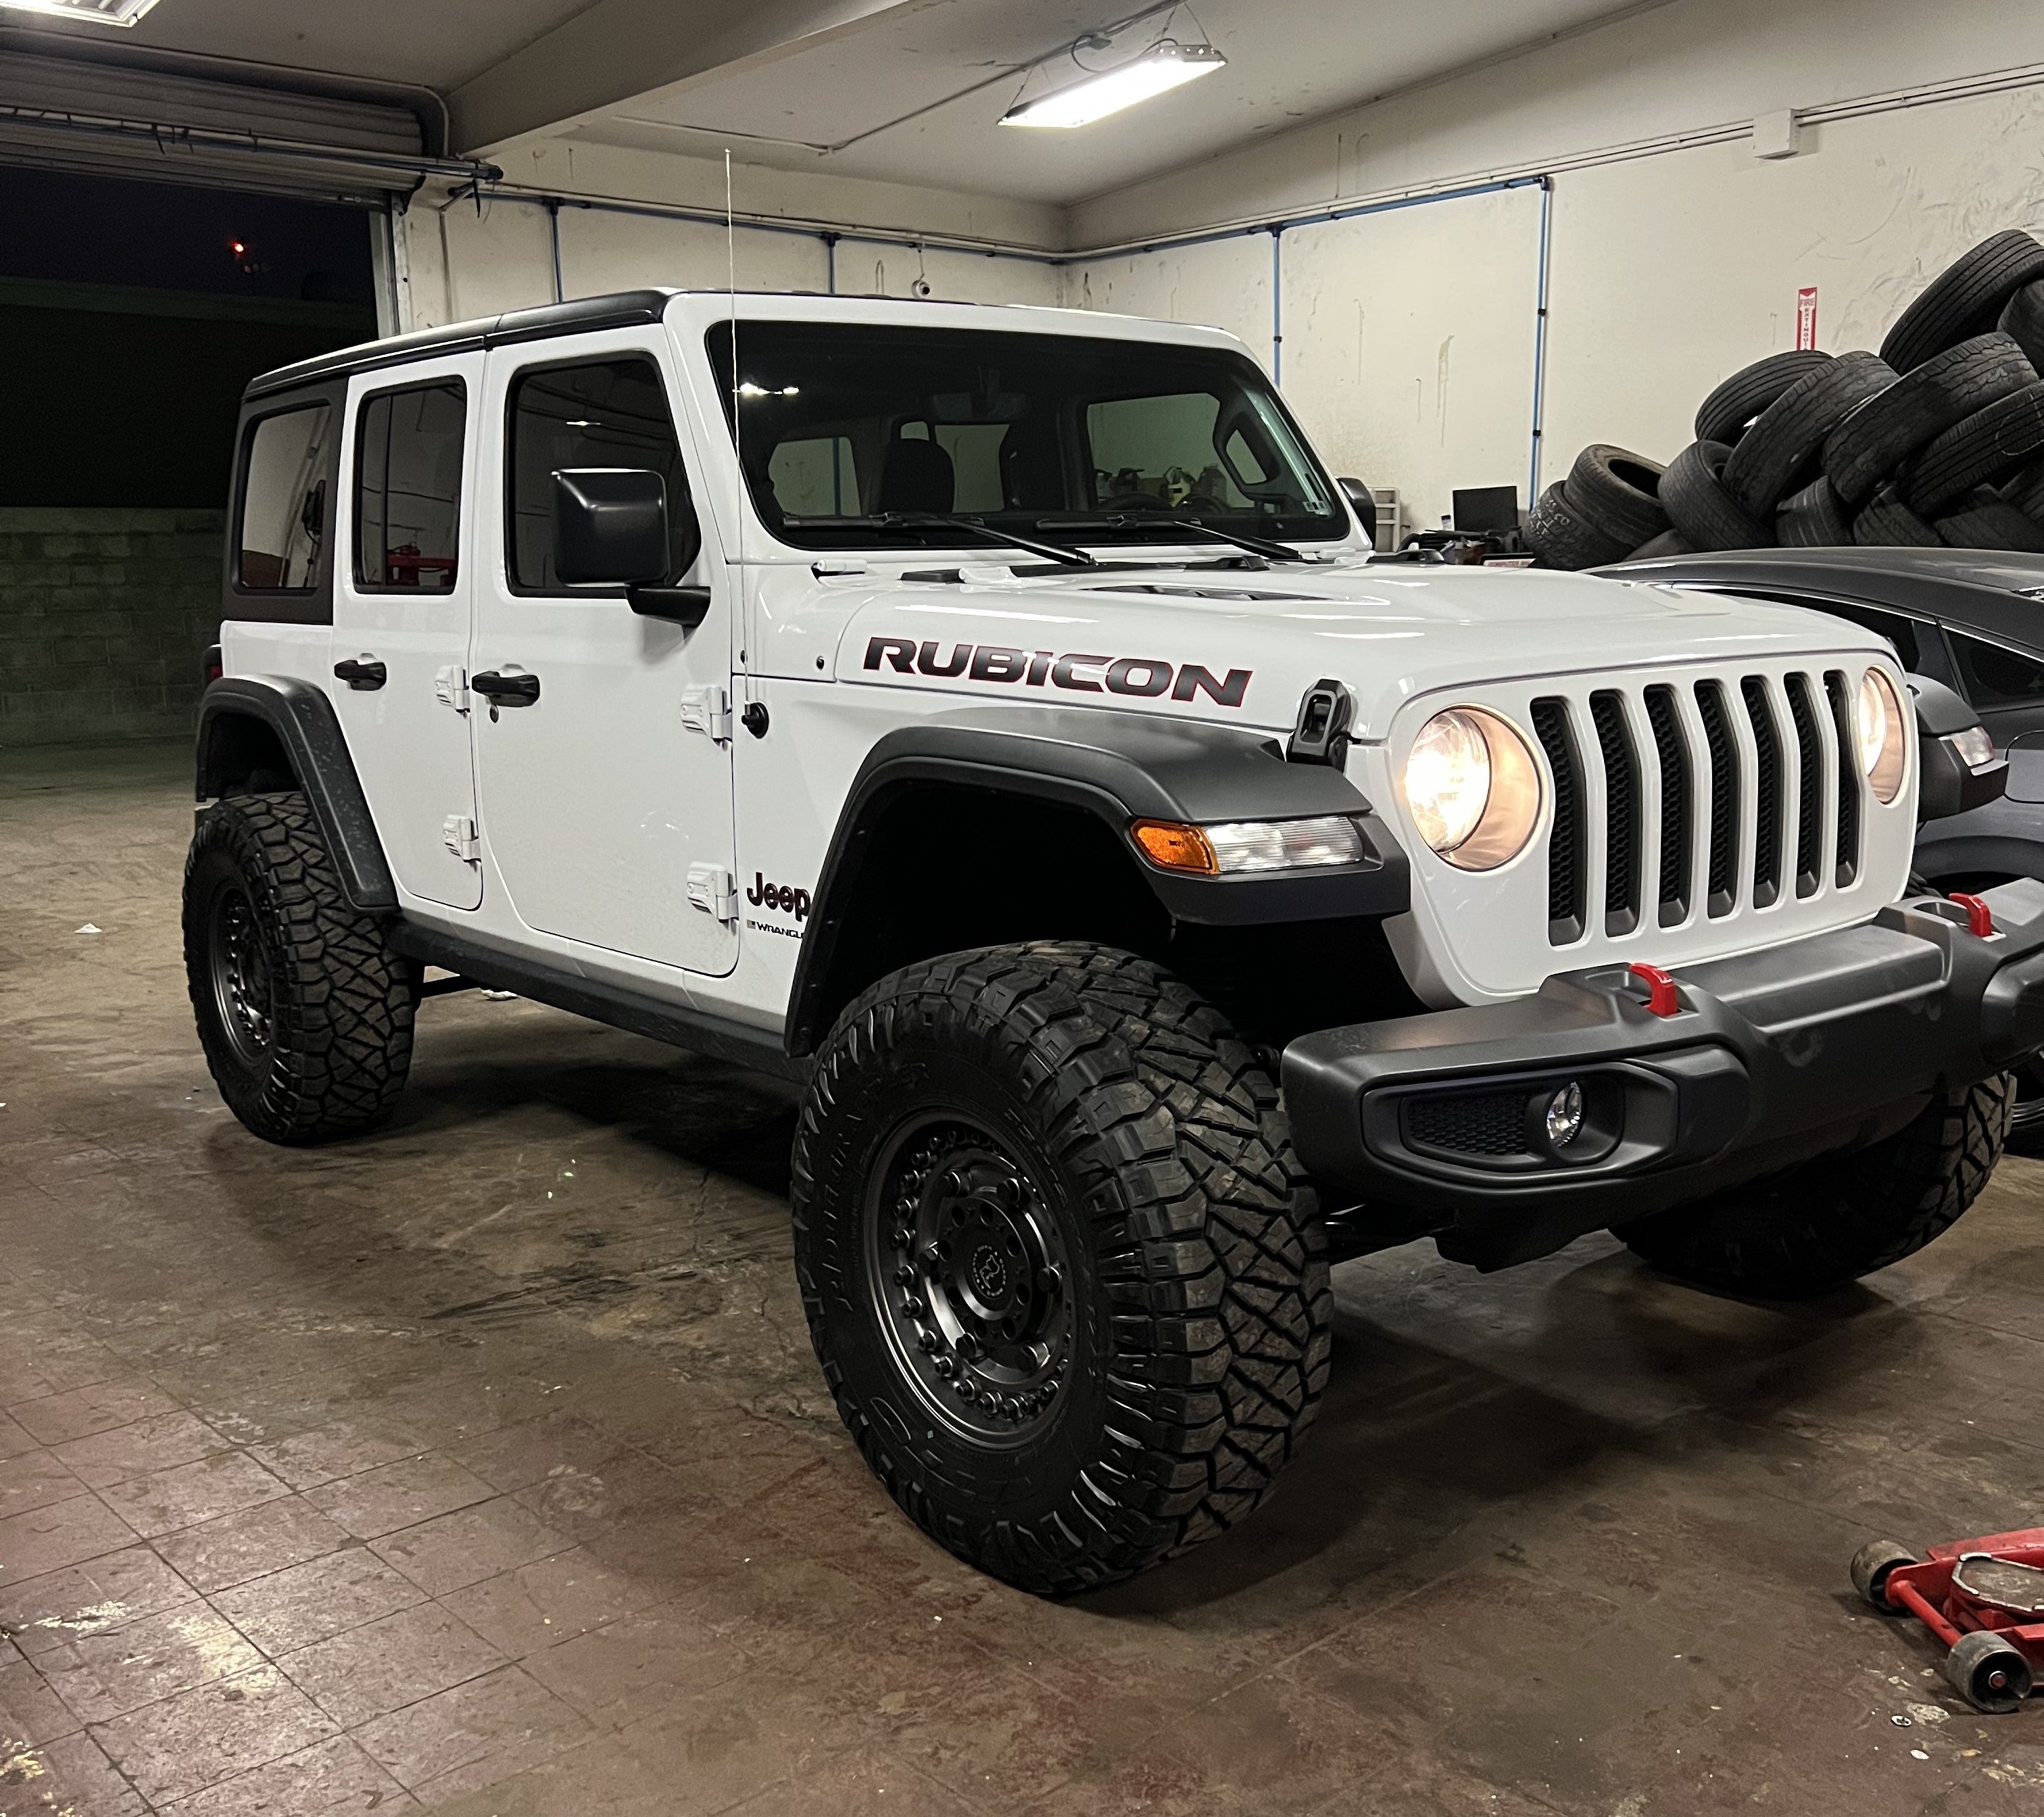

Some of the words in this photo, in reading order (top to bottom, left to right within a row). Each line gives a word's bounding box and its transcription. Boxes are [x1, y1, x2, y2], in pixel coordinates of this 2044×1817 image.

[1799, 298, 1815, 308] FIRE
[863, 637, 1253, 707] RUBICON
[746, 871, 810, 922] Jeep
